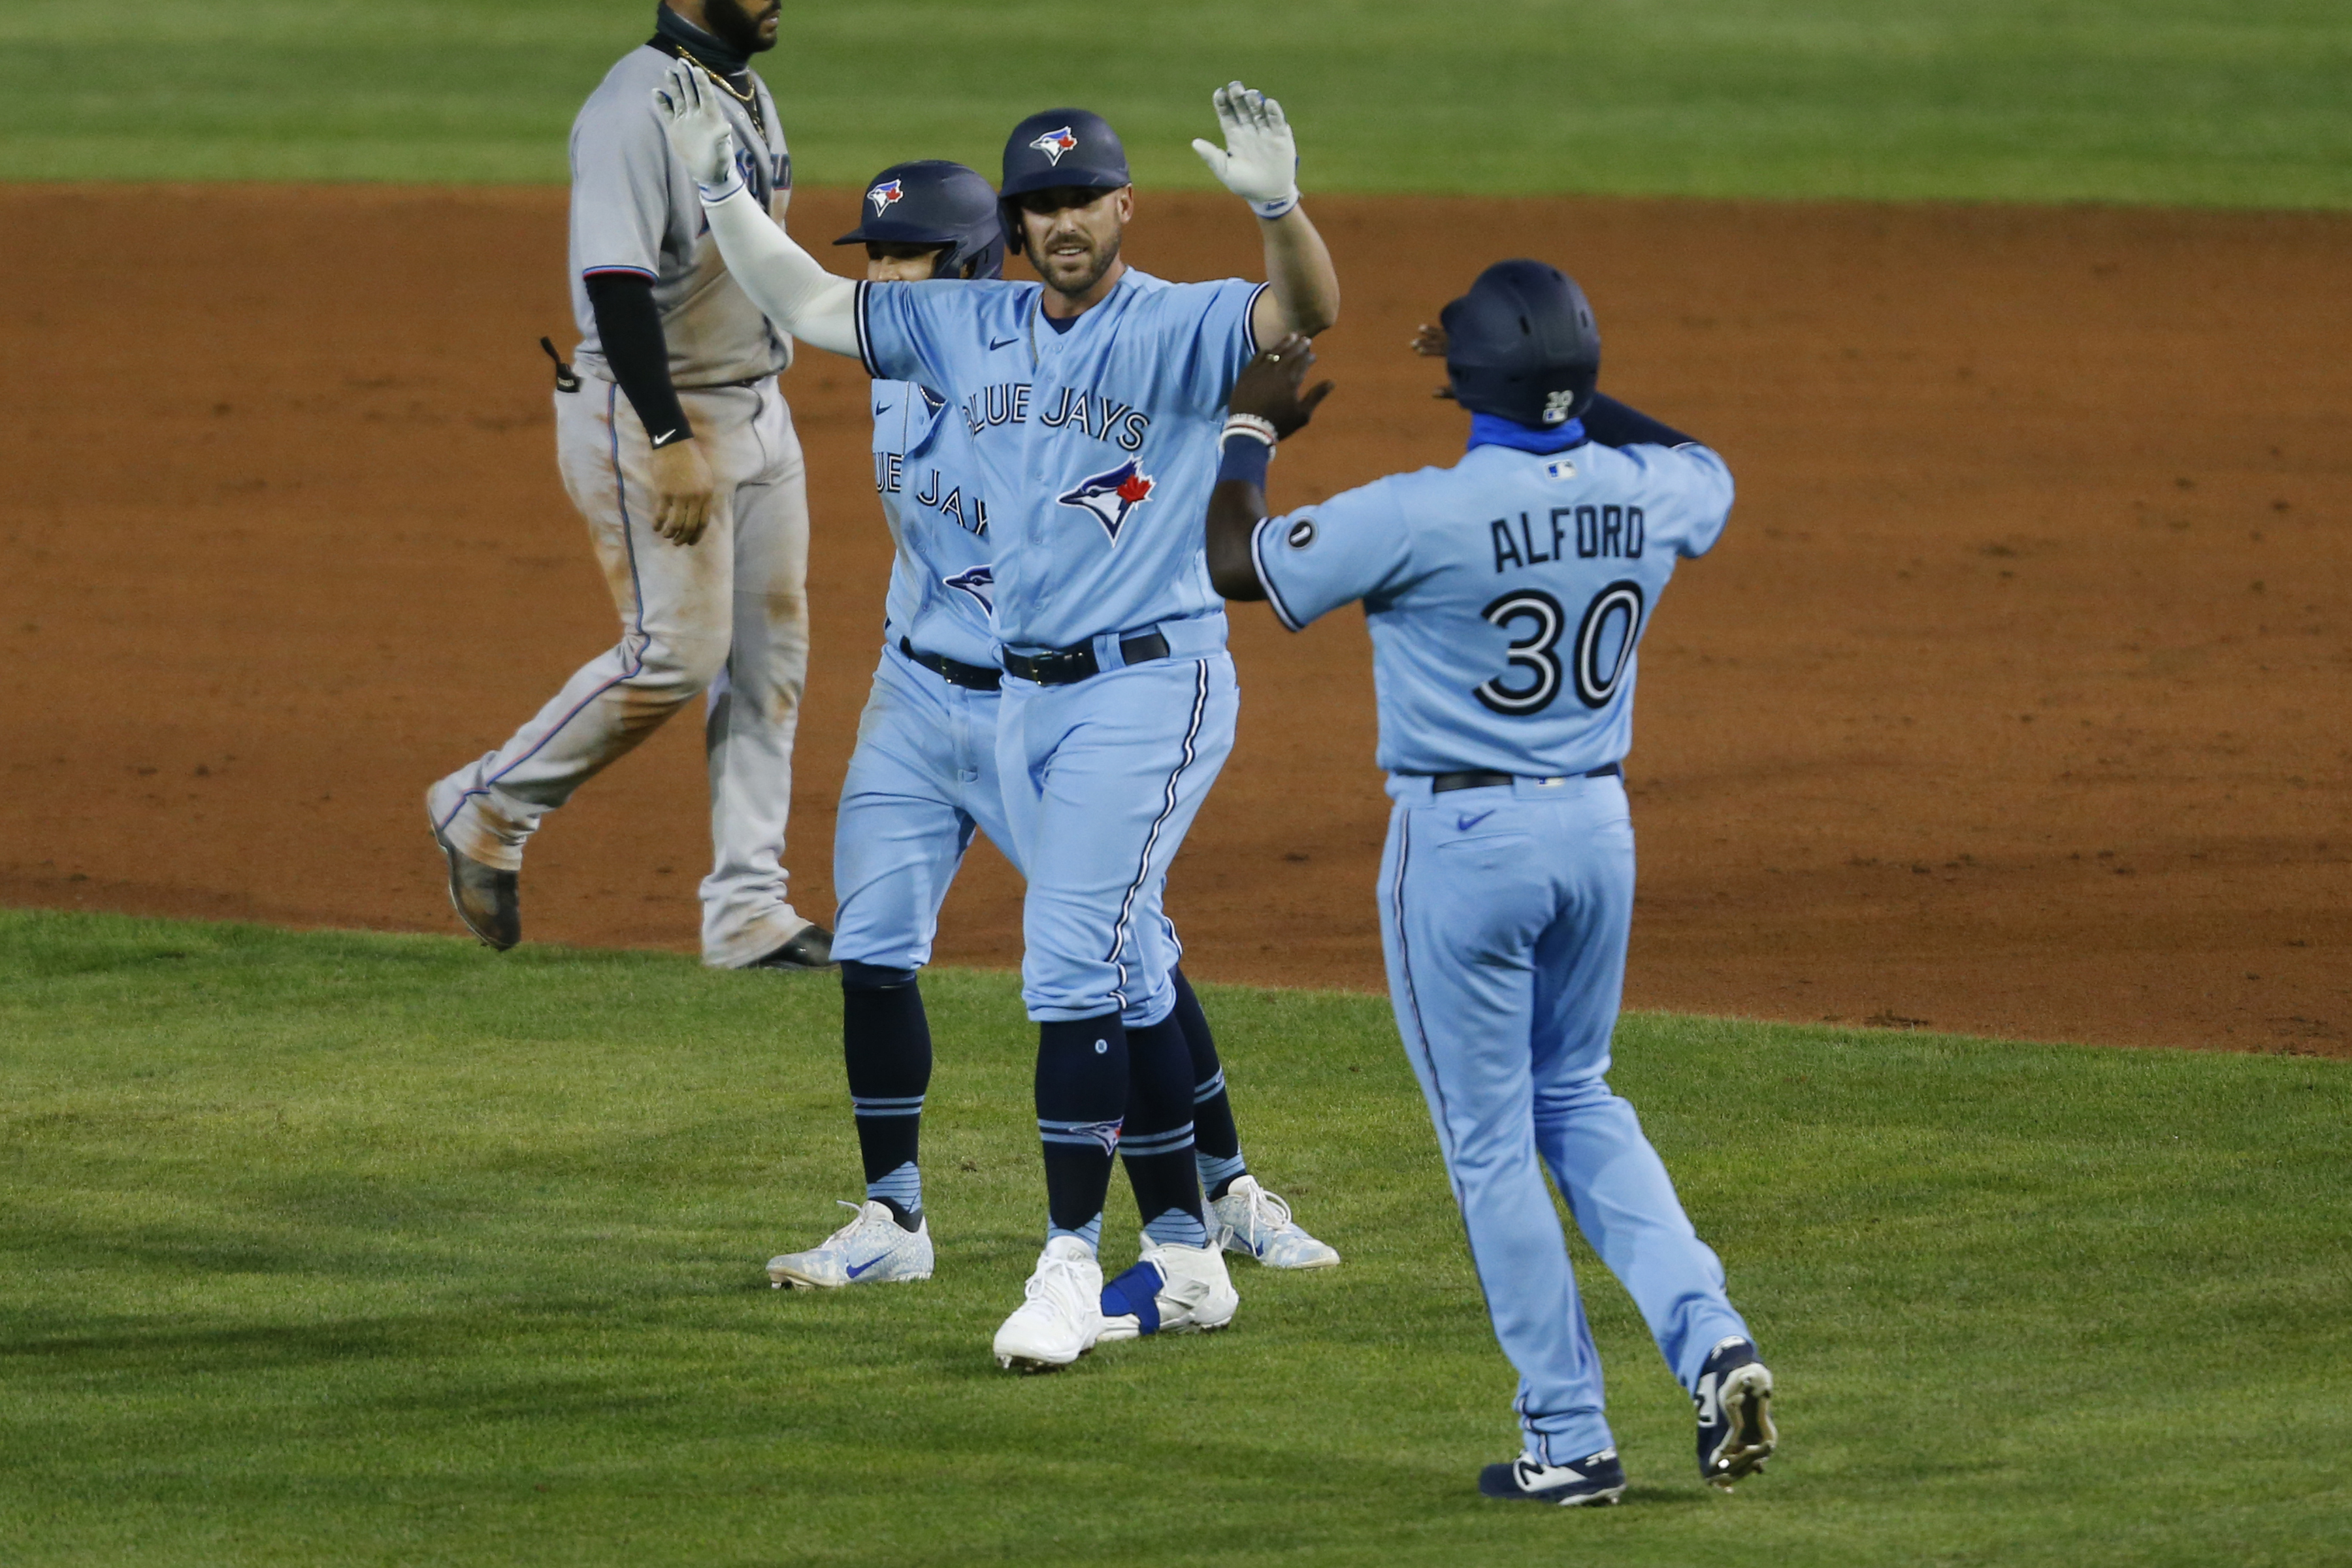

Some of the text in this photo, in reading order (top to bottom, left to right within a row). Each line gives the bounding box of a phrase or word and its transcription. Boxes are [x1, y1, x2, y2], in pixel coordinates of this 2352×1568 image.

[1040, 385, 1150, 451] JAYS
[1545, 389, 1574, 408] 30
[916, 468, 988, 536] JAY
[1491, 505, 1642, 573] ALFORD
[1473, 580, 1643, 715] 30
